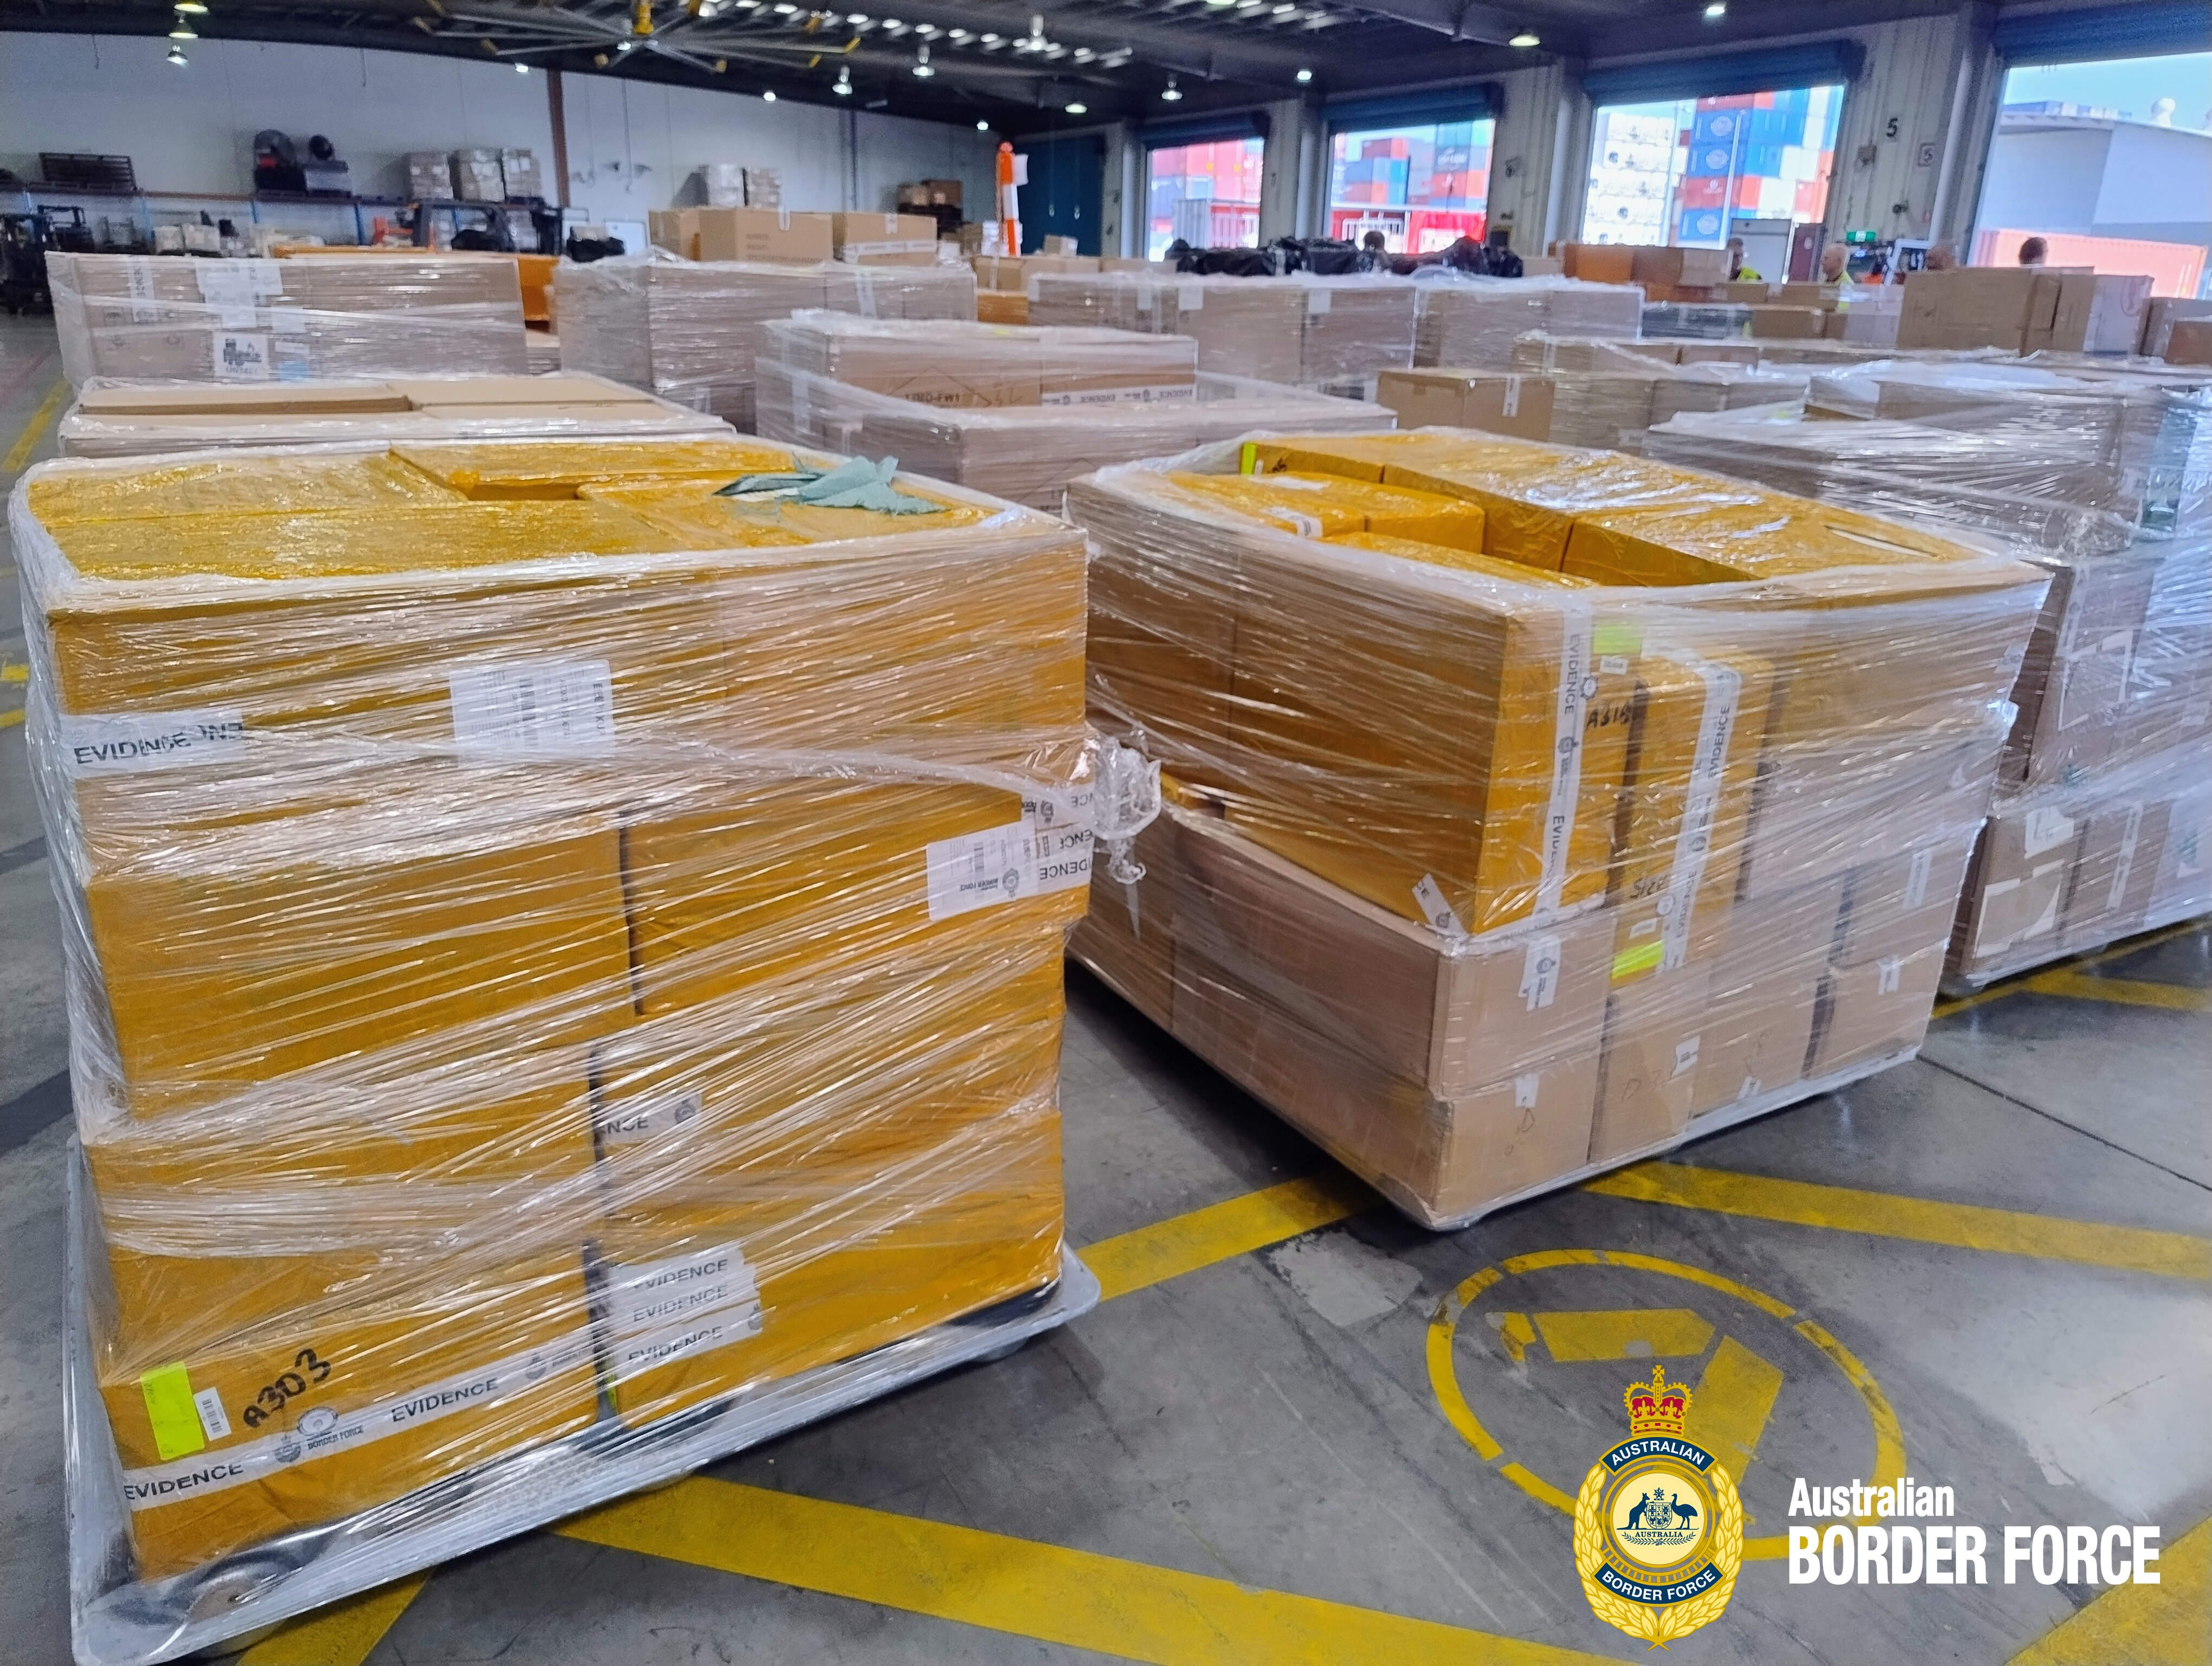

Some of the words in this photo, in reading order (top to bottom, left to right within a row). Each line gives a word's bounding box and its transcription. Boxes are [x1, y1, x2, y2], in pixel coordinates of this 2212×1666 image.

[1886, 117, 1899, 137] 5
[1564, 633, 1580, 716] EVIDENCE
[1708, 705, 1730, 779] EVIDENCE
[243, 1348, 332, 1428] A303
[124, 1463, 244, 1501] EVIDENCE
[339, 1425, 364, 1440] FORCE
[391, 1377, 499, 1423] EVIDENCE
